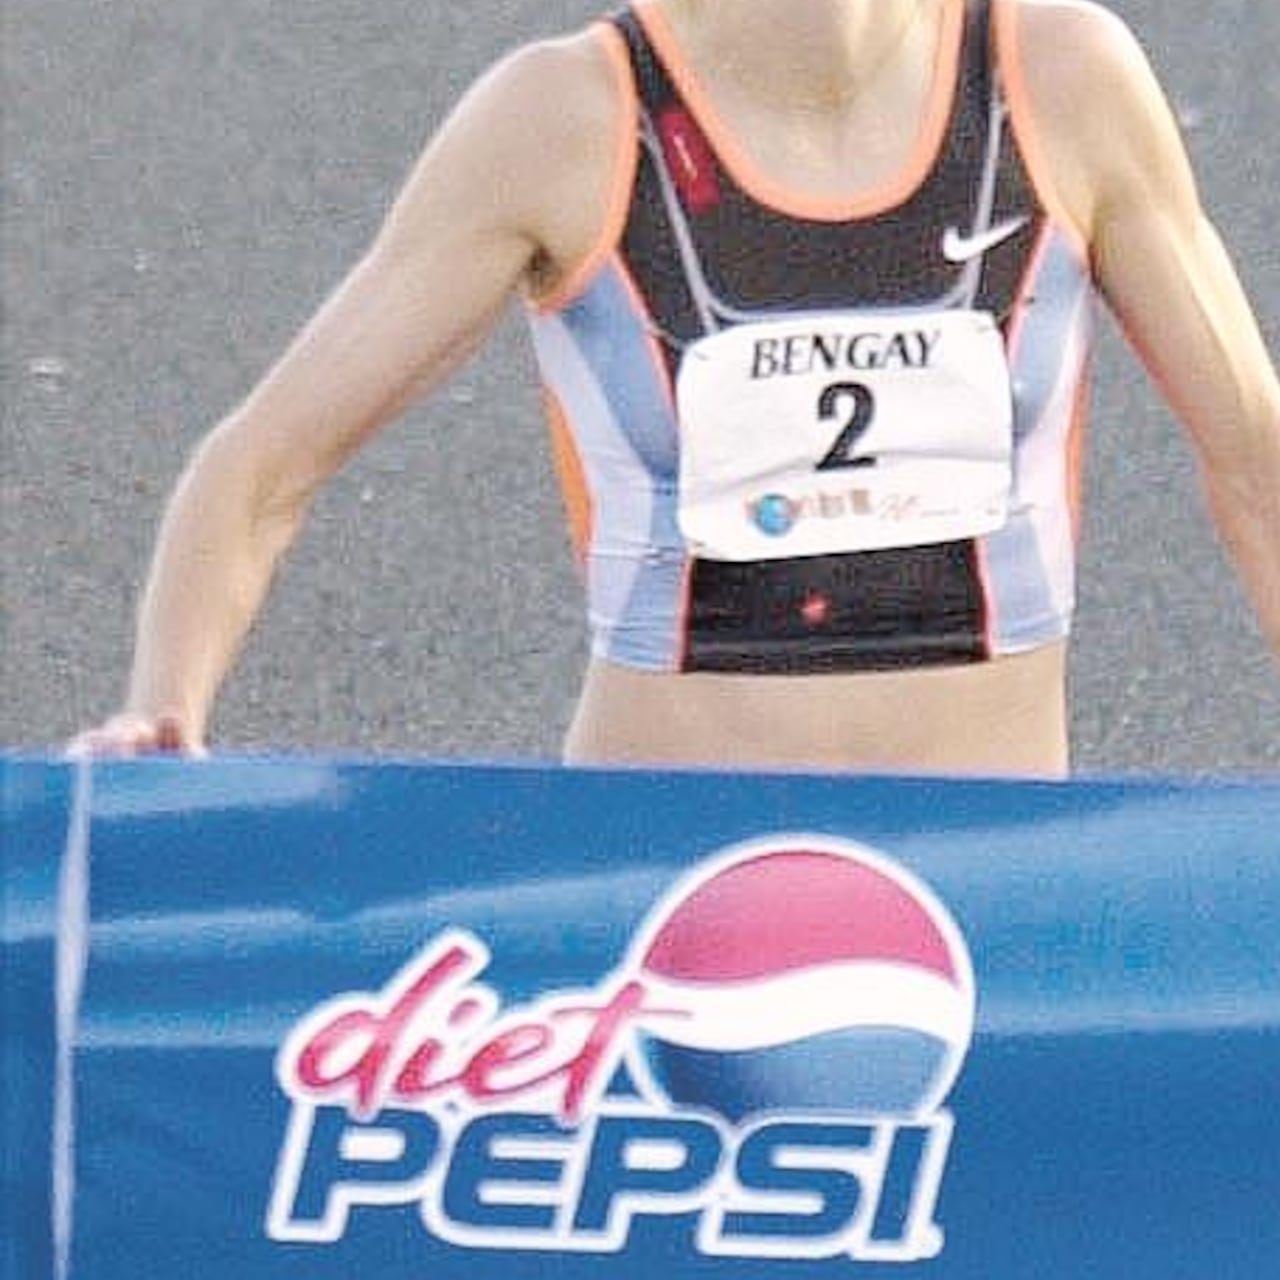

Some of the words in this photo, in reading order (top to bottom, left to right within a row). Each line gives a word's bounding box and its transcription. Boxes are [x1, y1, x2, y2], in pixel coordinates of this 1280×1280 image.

[748, 328, 941, 380] BENGAY
[814, 380, 876, 473] 2
[294, 942, 694, 1120] diet
[266, 1104, 956, 1262] PEPSI
